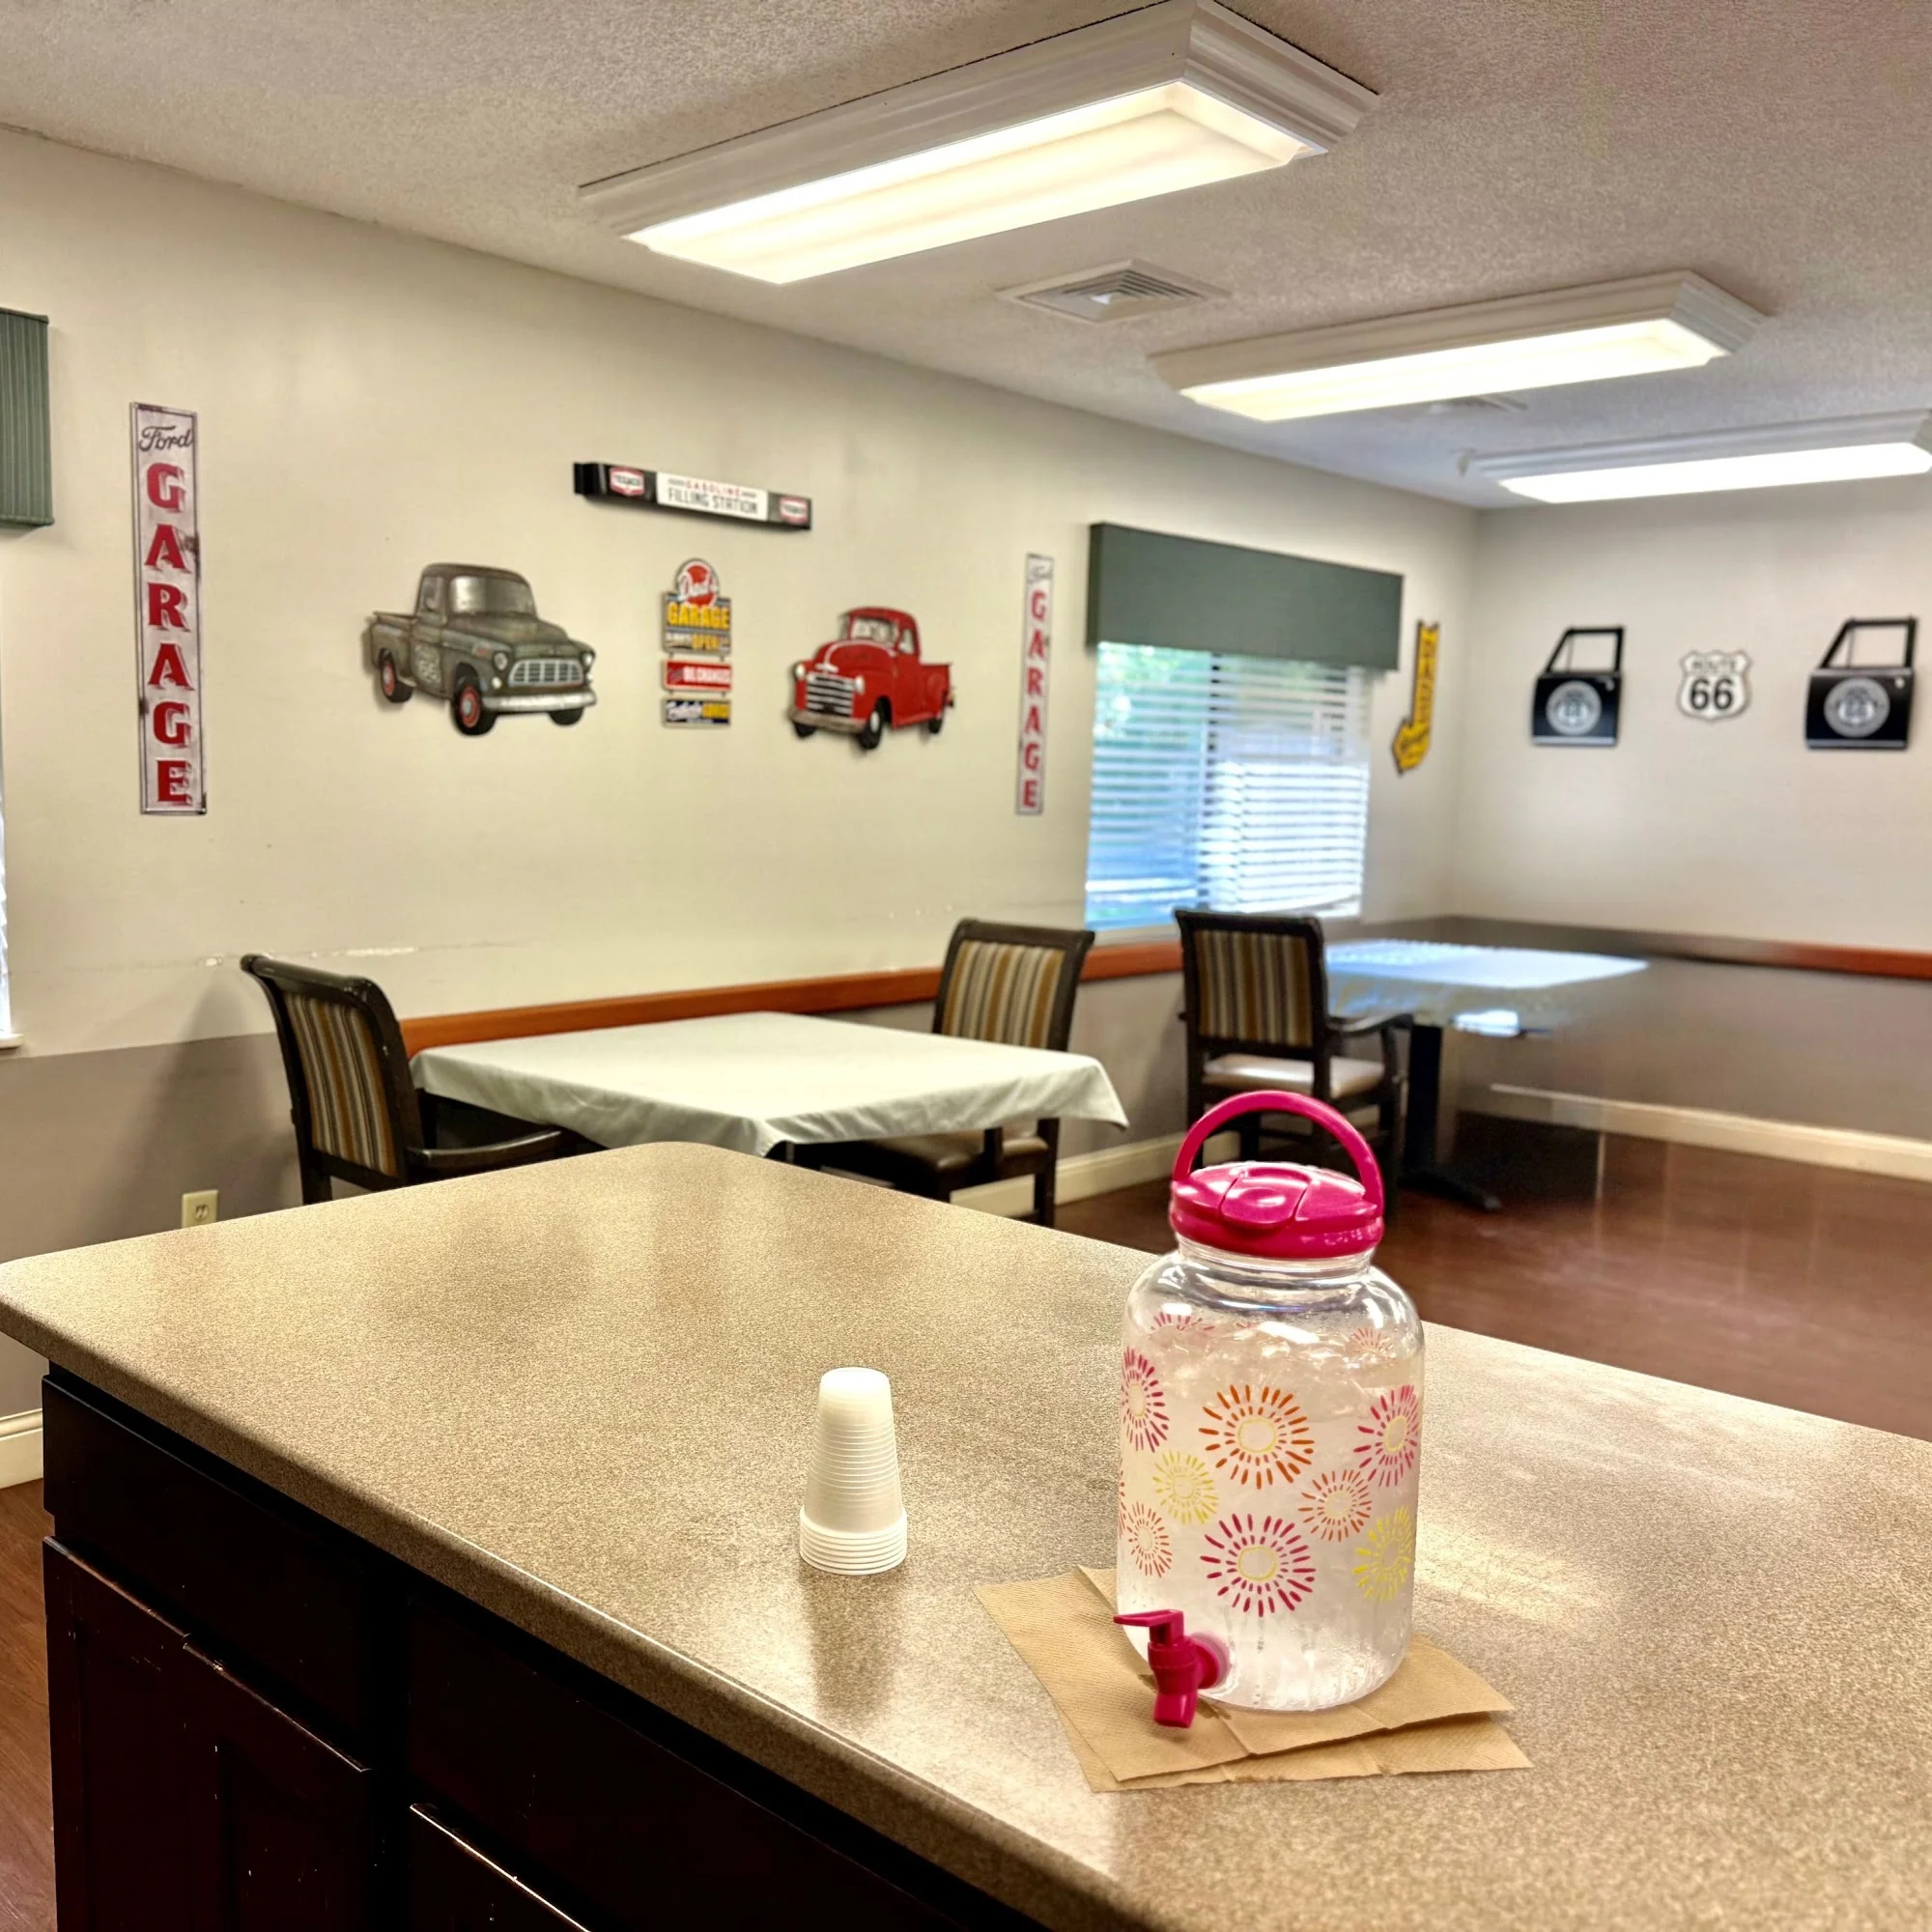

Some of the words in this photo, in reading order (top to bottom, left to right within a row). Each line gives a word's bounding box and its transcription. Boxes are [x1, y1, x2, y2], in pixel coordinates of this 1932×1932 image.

[138, 425, 193, 452] Ford
[668, 487, 710, 508] FILLING
[712, 495, 758, 514] STATION
[668, 602, 730, 630] GARAGE
[144, 462, 195, 808] GARAGE
[1023, 589, 1047, 809] GARAGE
[1690, 676, 1734, 710] 66
